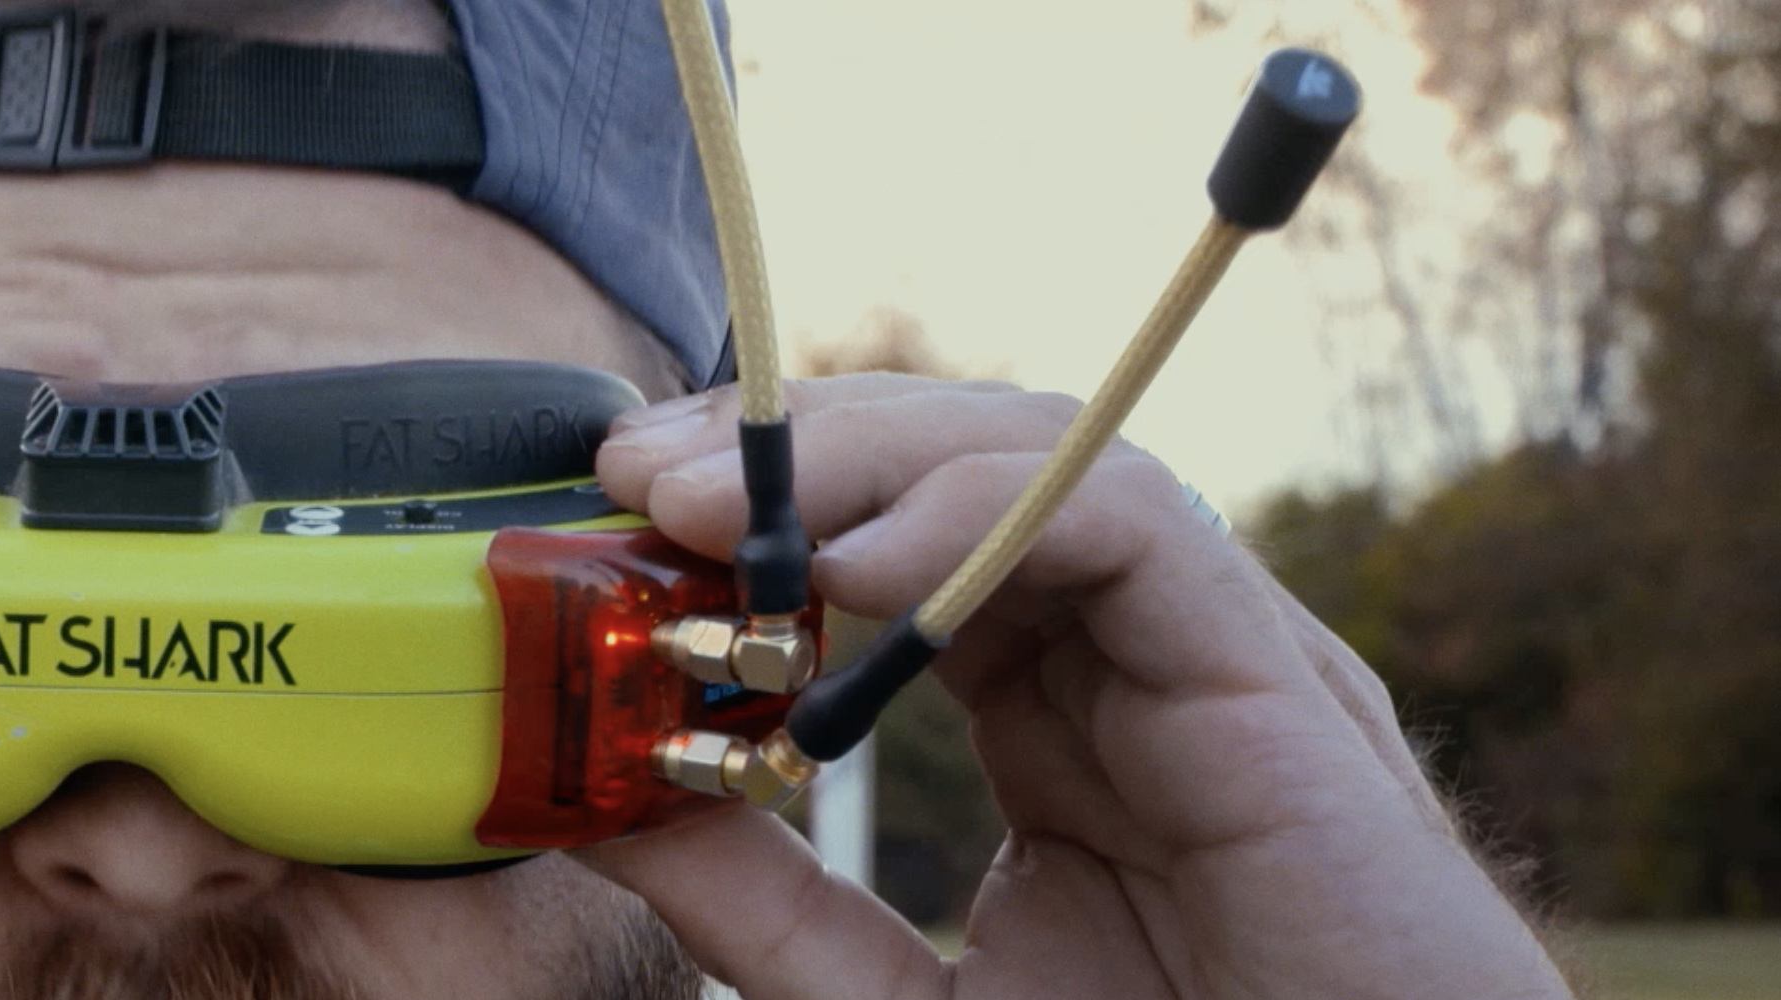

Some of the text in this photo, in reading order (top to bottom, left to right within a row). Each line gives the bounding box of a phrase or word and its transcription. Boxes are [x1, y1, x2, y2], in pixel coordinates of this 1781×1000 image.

[339, 406, 589, 473] FAT SHARK
[55, 614, 298, 687] SHARK
